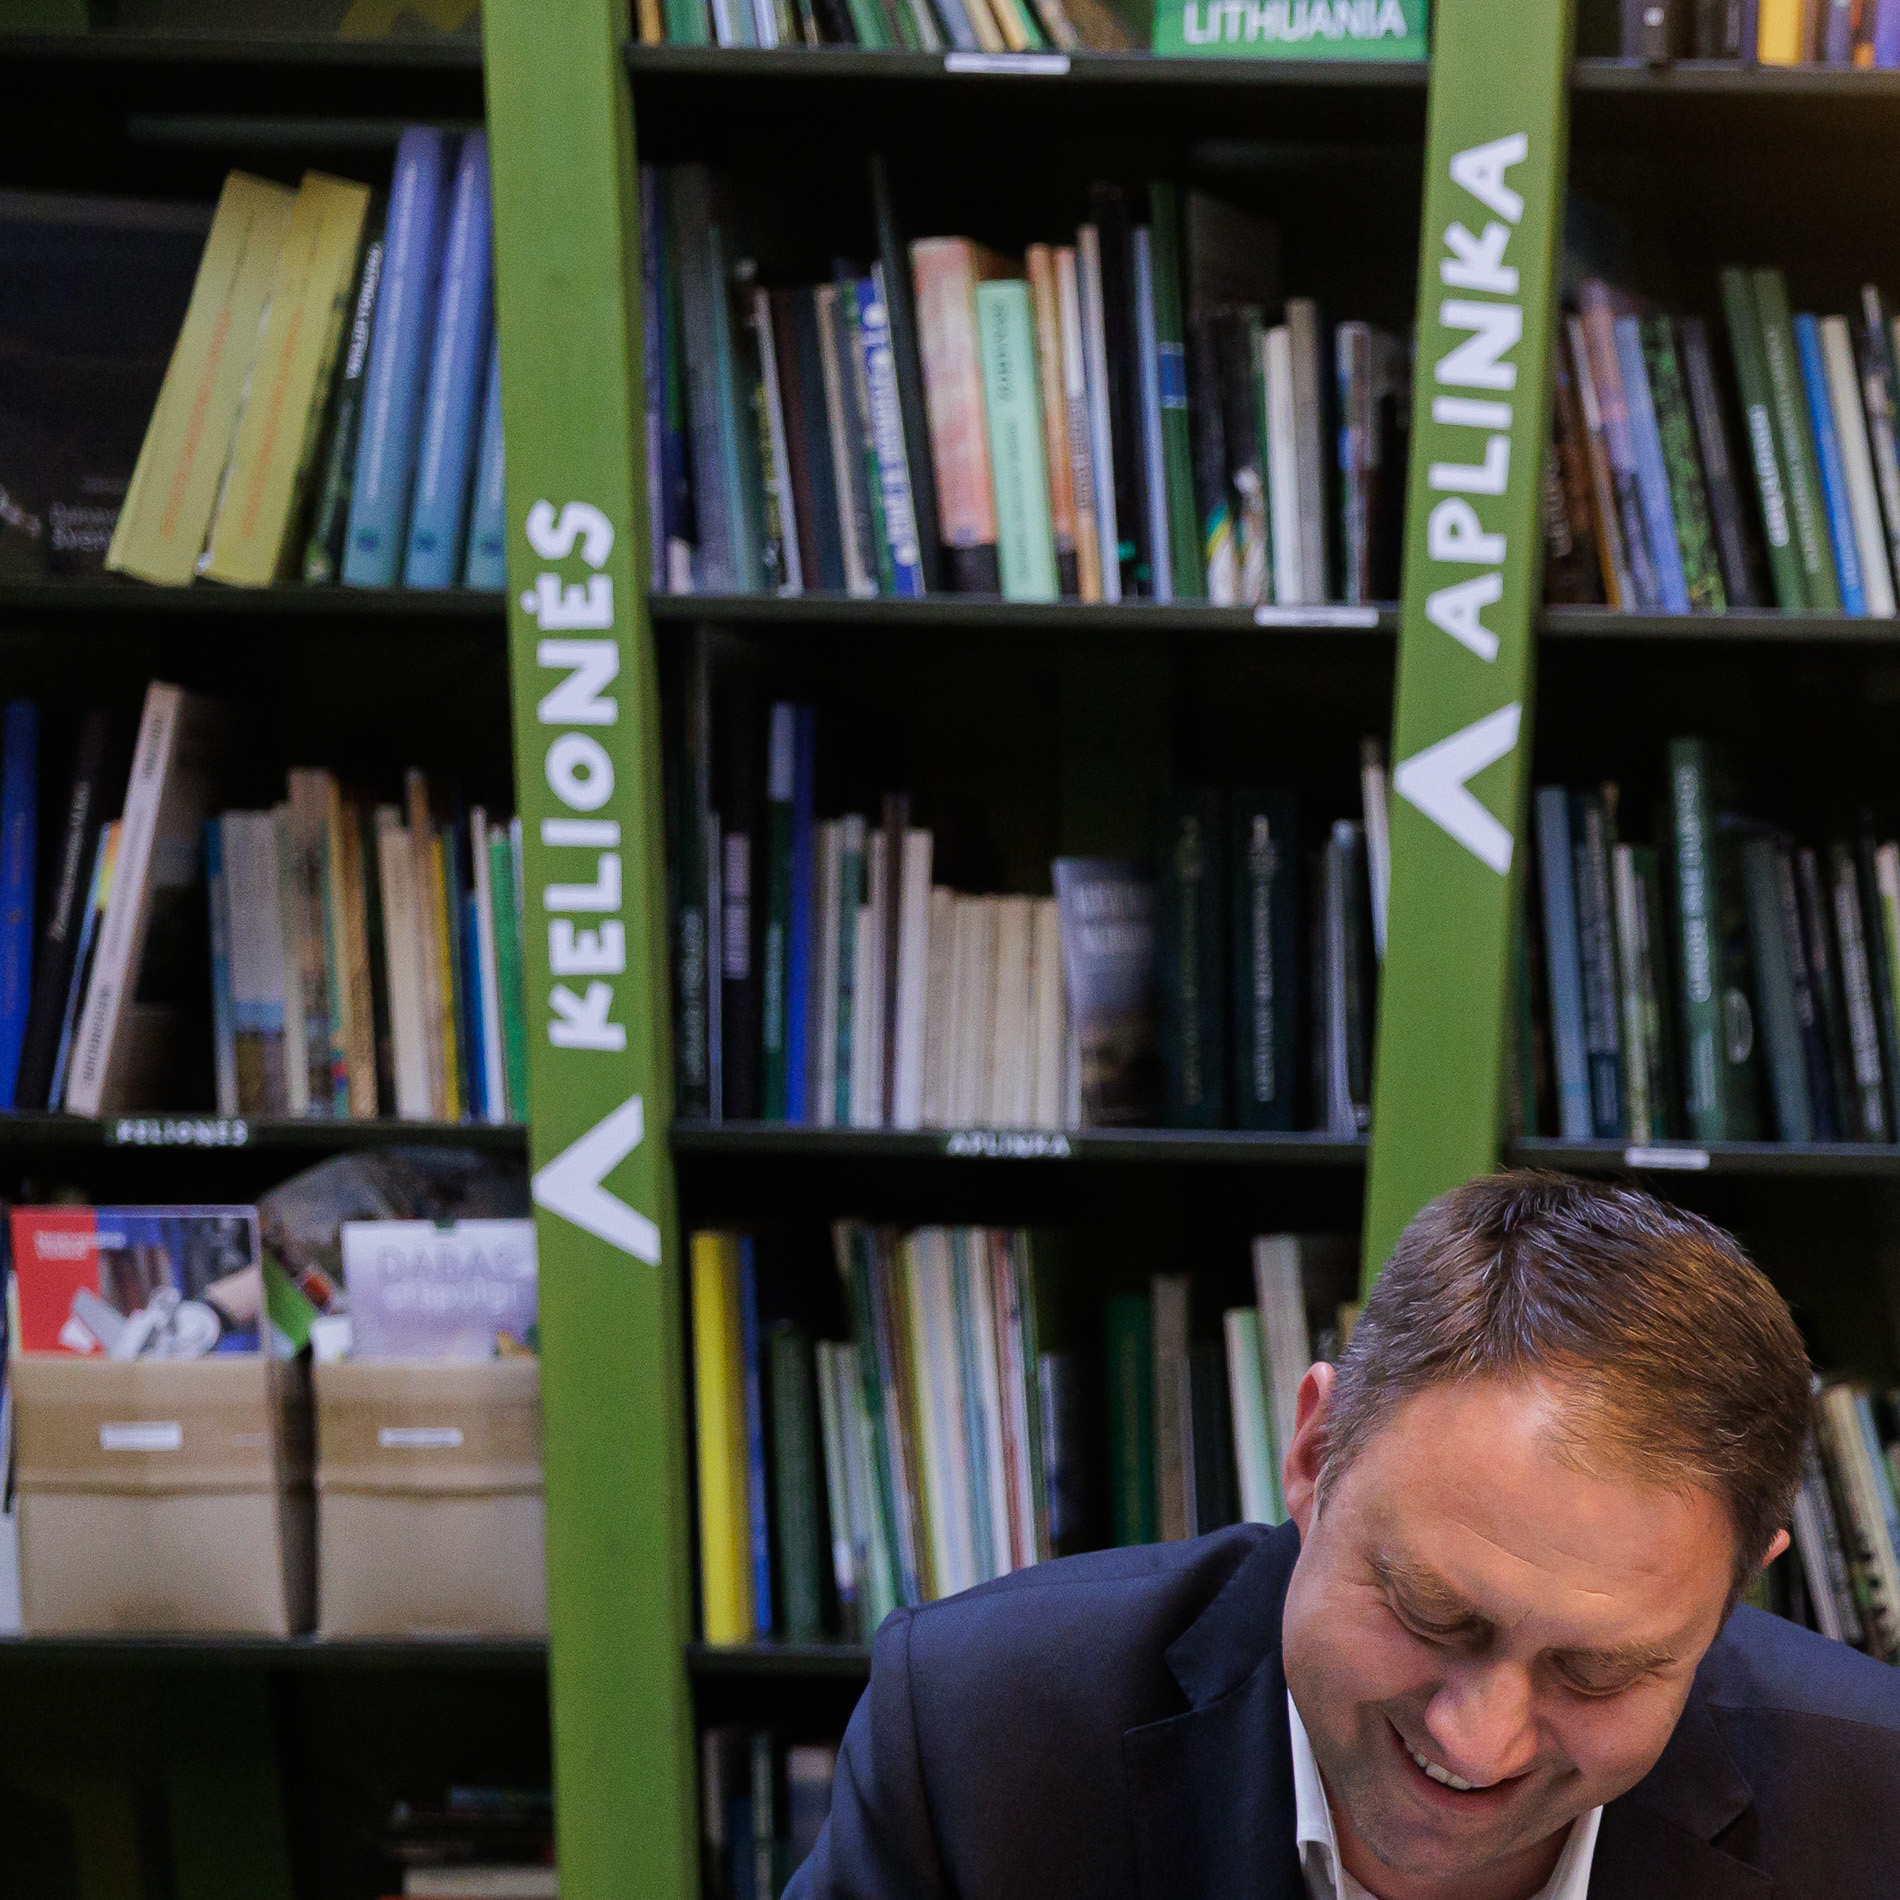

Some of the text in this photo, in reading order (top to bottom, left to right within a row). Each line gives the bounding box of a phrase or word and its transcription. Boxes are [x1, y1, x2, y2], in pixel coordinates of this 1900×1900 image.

[1183, 0, 1408, 45] LITHUANIA
[1422, 131, 1529, 663] APLINKA
[519, 500, 627, 1051] KELIONĖS
